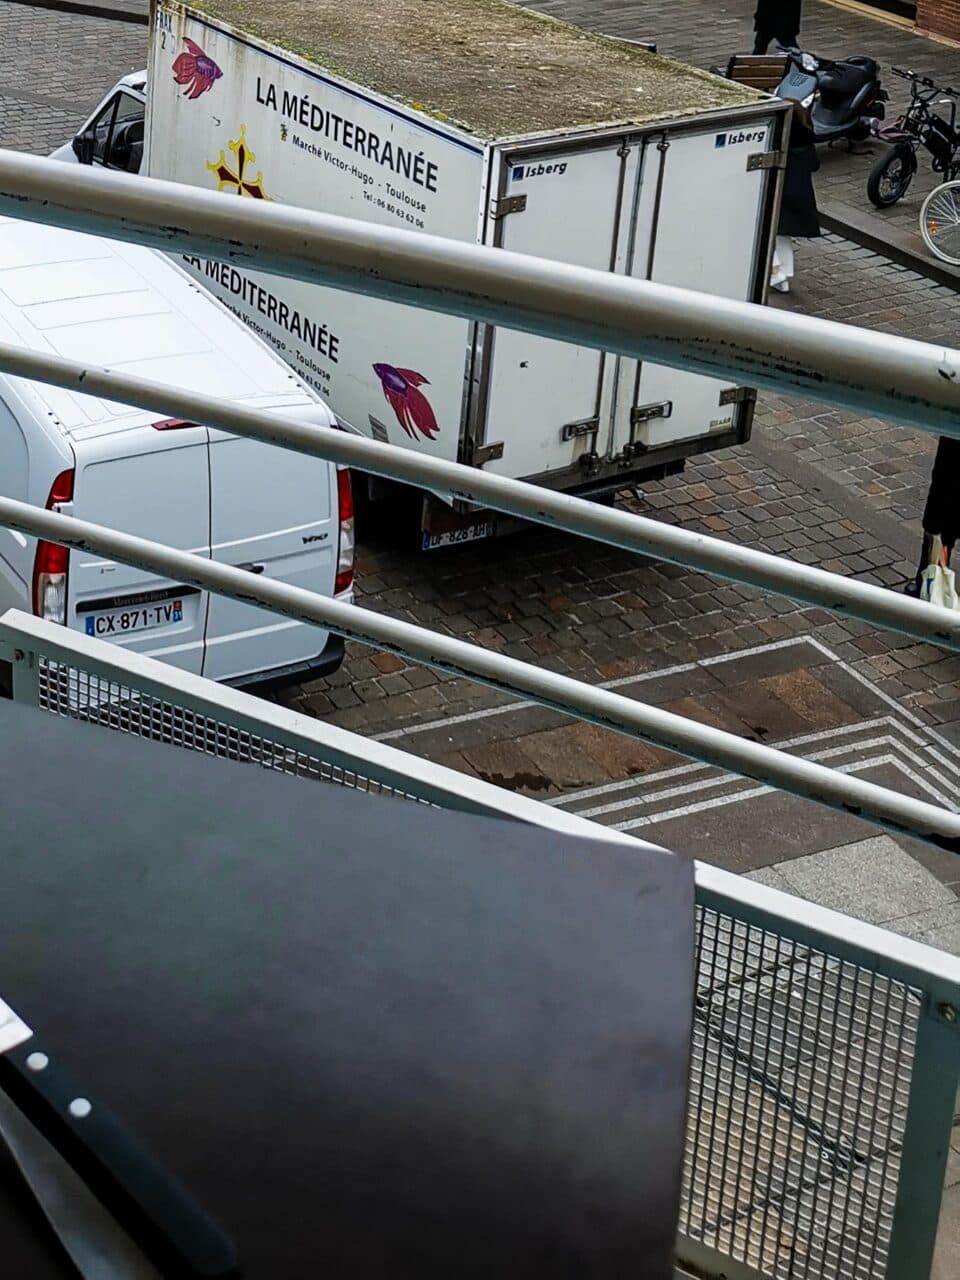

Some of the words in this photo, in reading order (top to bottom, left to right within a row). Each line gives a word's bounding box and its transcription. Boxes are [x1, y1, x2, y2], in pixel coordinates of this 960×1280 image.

[256, 77, 277, 111] LA
[282, 91, 439, 193] MÉDITERRANÉE
[728, 131, 766, 146] Isberg
[292, 134, 322, 158] Marché
[324, 150, 374, 185] Victor-Hugo
[386, 182, 427, 213] Toulouse
[525, 161, 568, 178] Isberg
[295, 349, 331, 382] Toulouse
[96, 604, 172, 634] CX-871-TV
